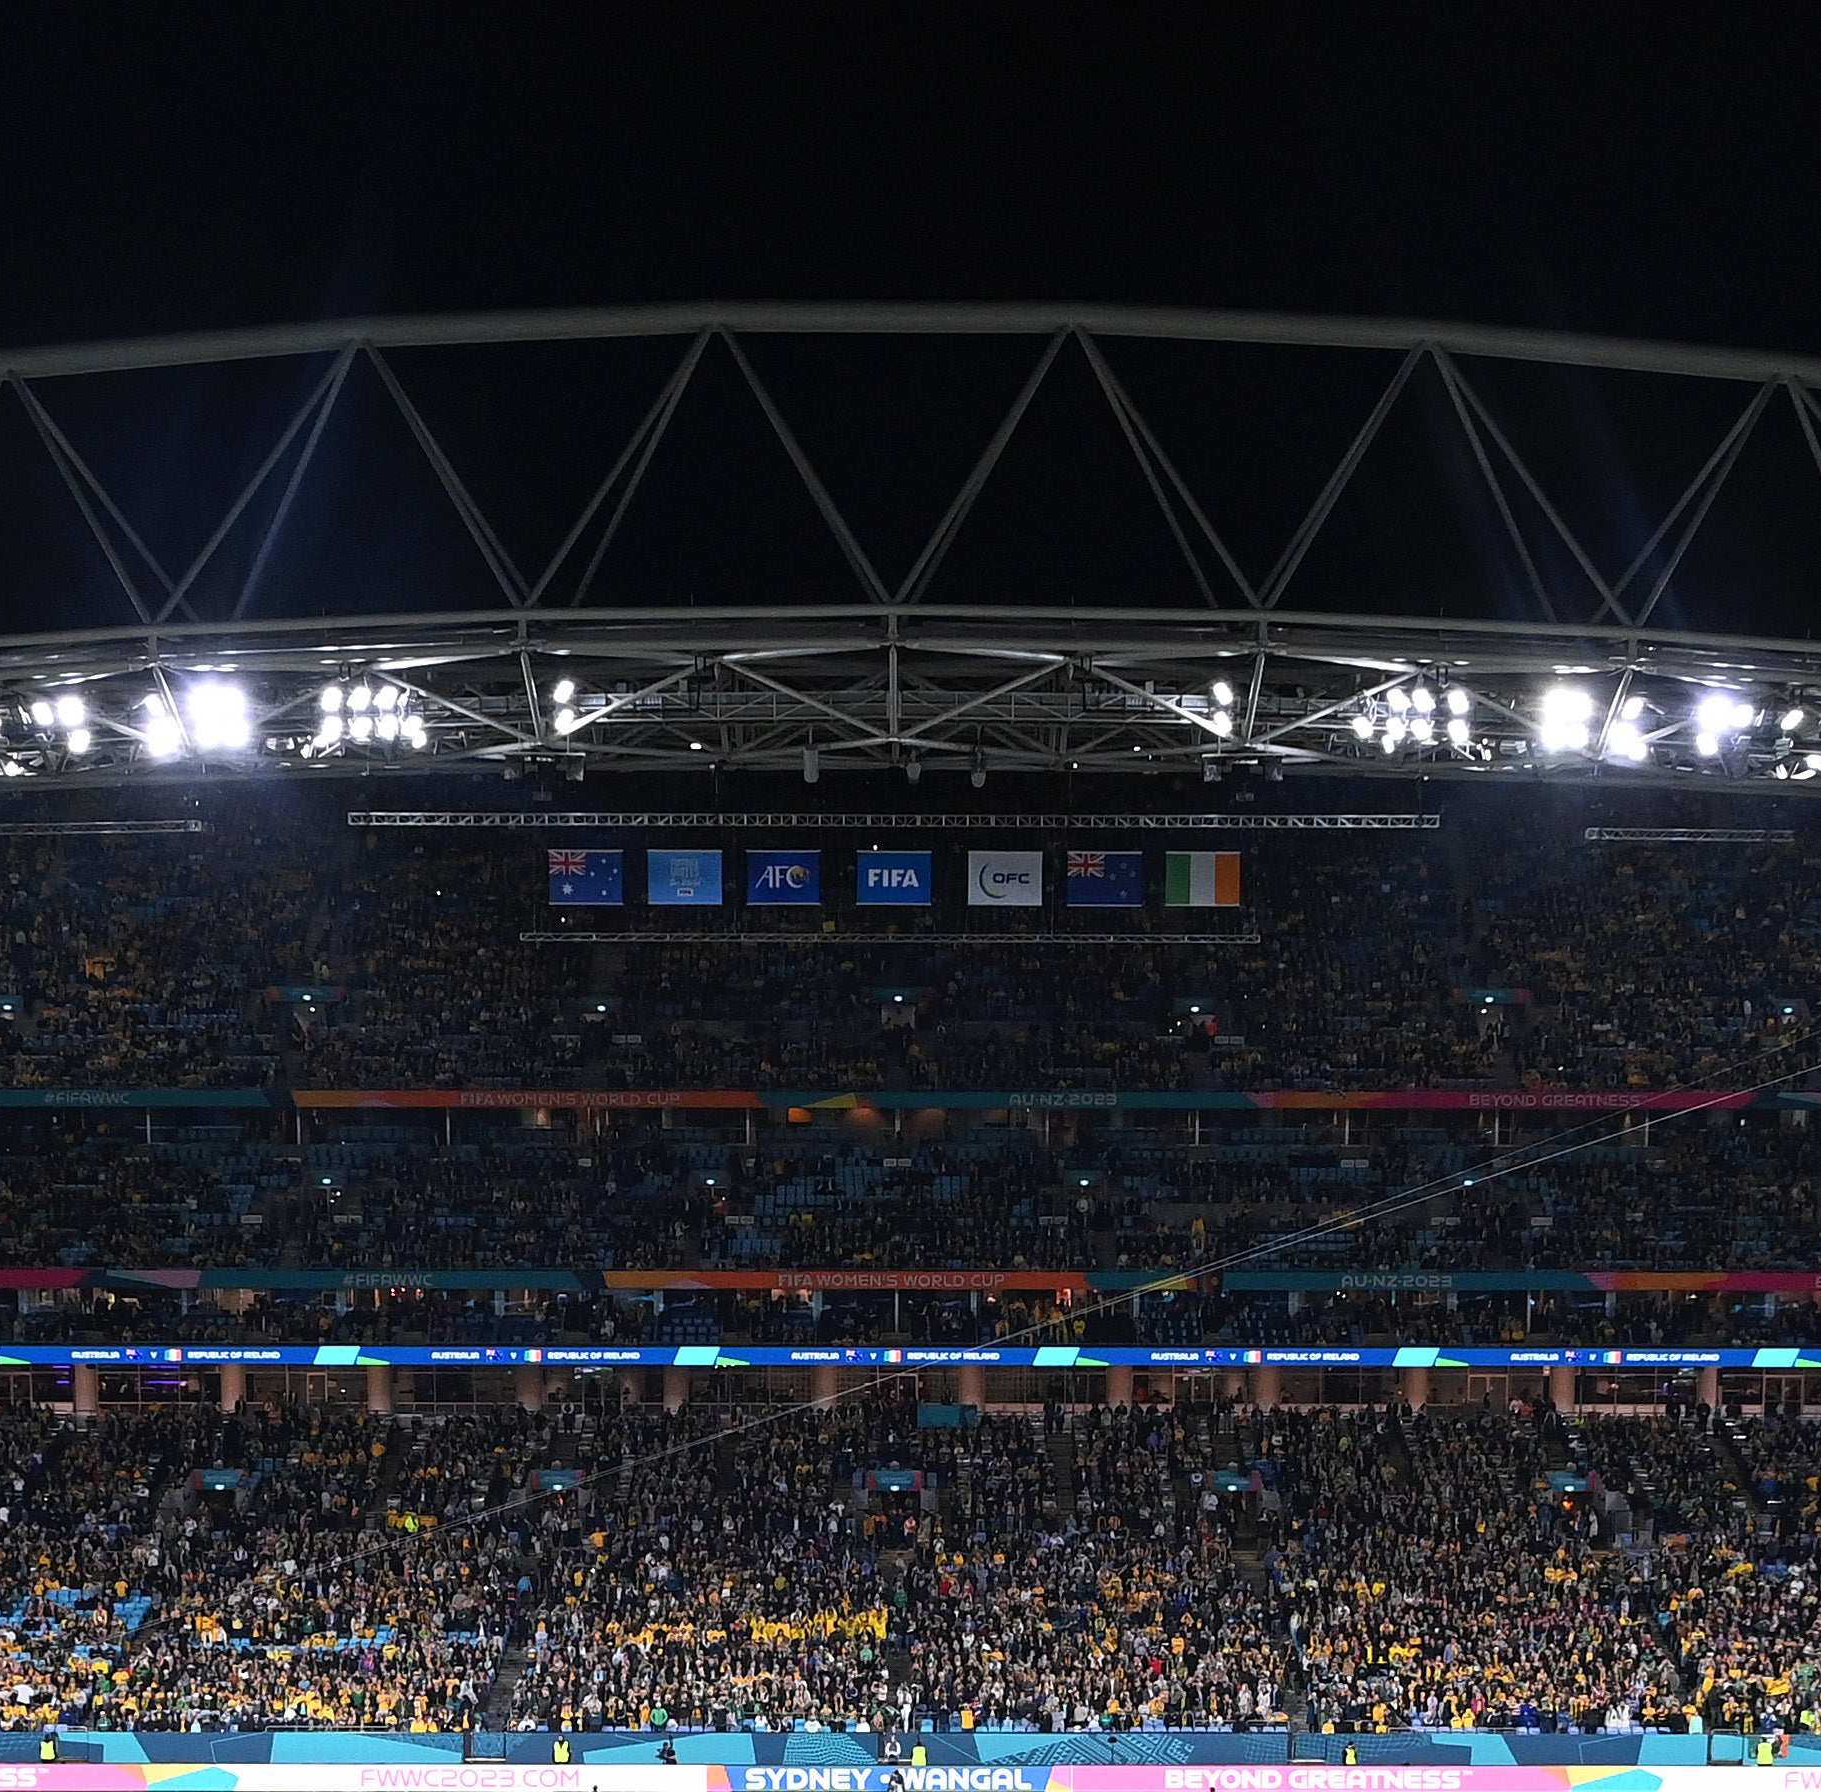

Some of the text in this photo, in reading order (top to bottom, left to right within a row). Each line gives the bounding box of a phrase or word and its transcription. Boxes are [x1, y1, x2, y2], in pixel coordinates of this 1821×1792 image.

[867, 868, 920, 889] FIFA
[992, 871, 1031, 886] OFC
[460, 1093, 681, 1106] FIFA WOMEN'S WORLD CUP
[1469, 1094, 1537, 1107] BEYOND
[342, 1274, 434, 1287] #FIFAWWC
[778, 1274, 1005, 1287] FIFA WOMEN'S WORLD CUP
[71, 1351, 121, 1359] AUSTRALIA
[187, 1351, 230, 1359] REPUBLIC
[244, 1351, 282, 1359] IRELAND
[431, 1351, 480, 1359] AUSTRALIA
[547, 1351, 590, 1360] REPUBLIC
[604, 1351, 642, 1360] IRELAND
[791, 1352, 840, 1360] AUSTRALIA
[963, 1352, 1001, 1360] IRELAND
[1150, 1352, 1200, 1361] AUSTRALIA
[1266, 1353, 1309, 1361] REPUBLIC
[1323, 1353, 1361, 1361] IRELAND
[1510, 1353, 1560, 1361] AUSTRALIA
[1626, 1353, 1669, 1361] REPUBLIC
[1683, 1353, 1721, 1361] IRELAND
[361, 1768, 580, 1788] FWWC2023.COM
[744, 1767, 873, 1791] SYDNEY
[1164, 1768, 1283, 1790] BEYOND
